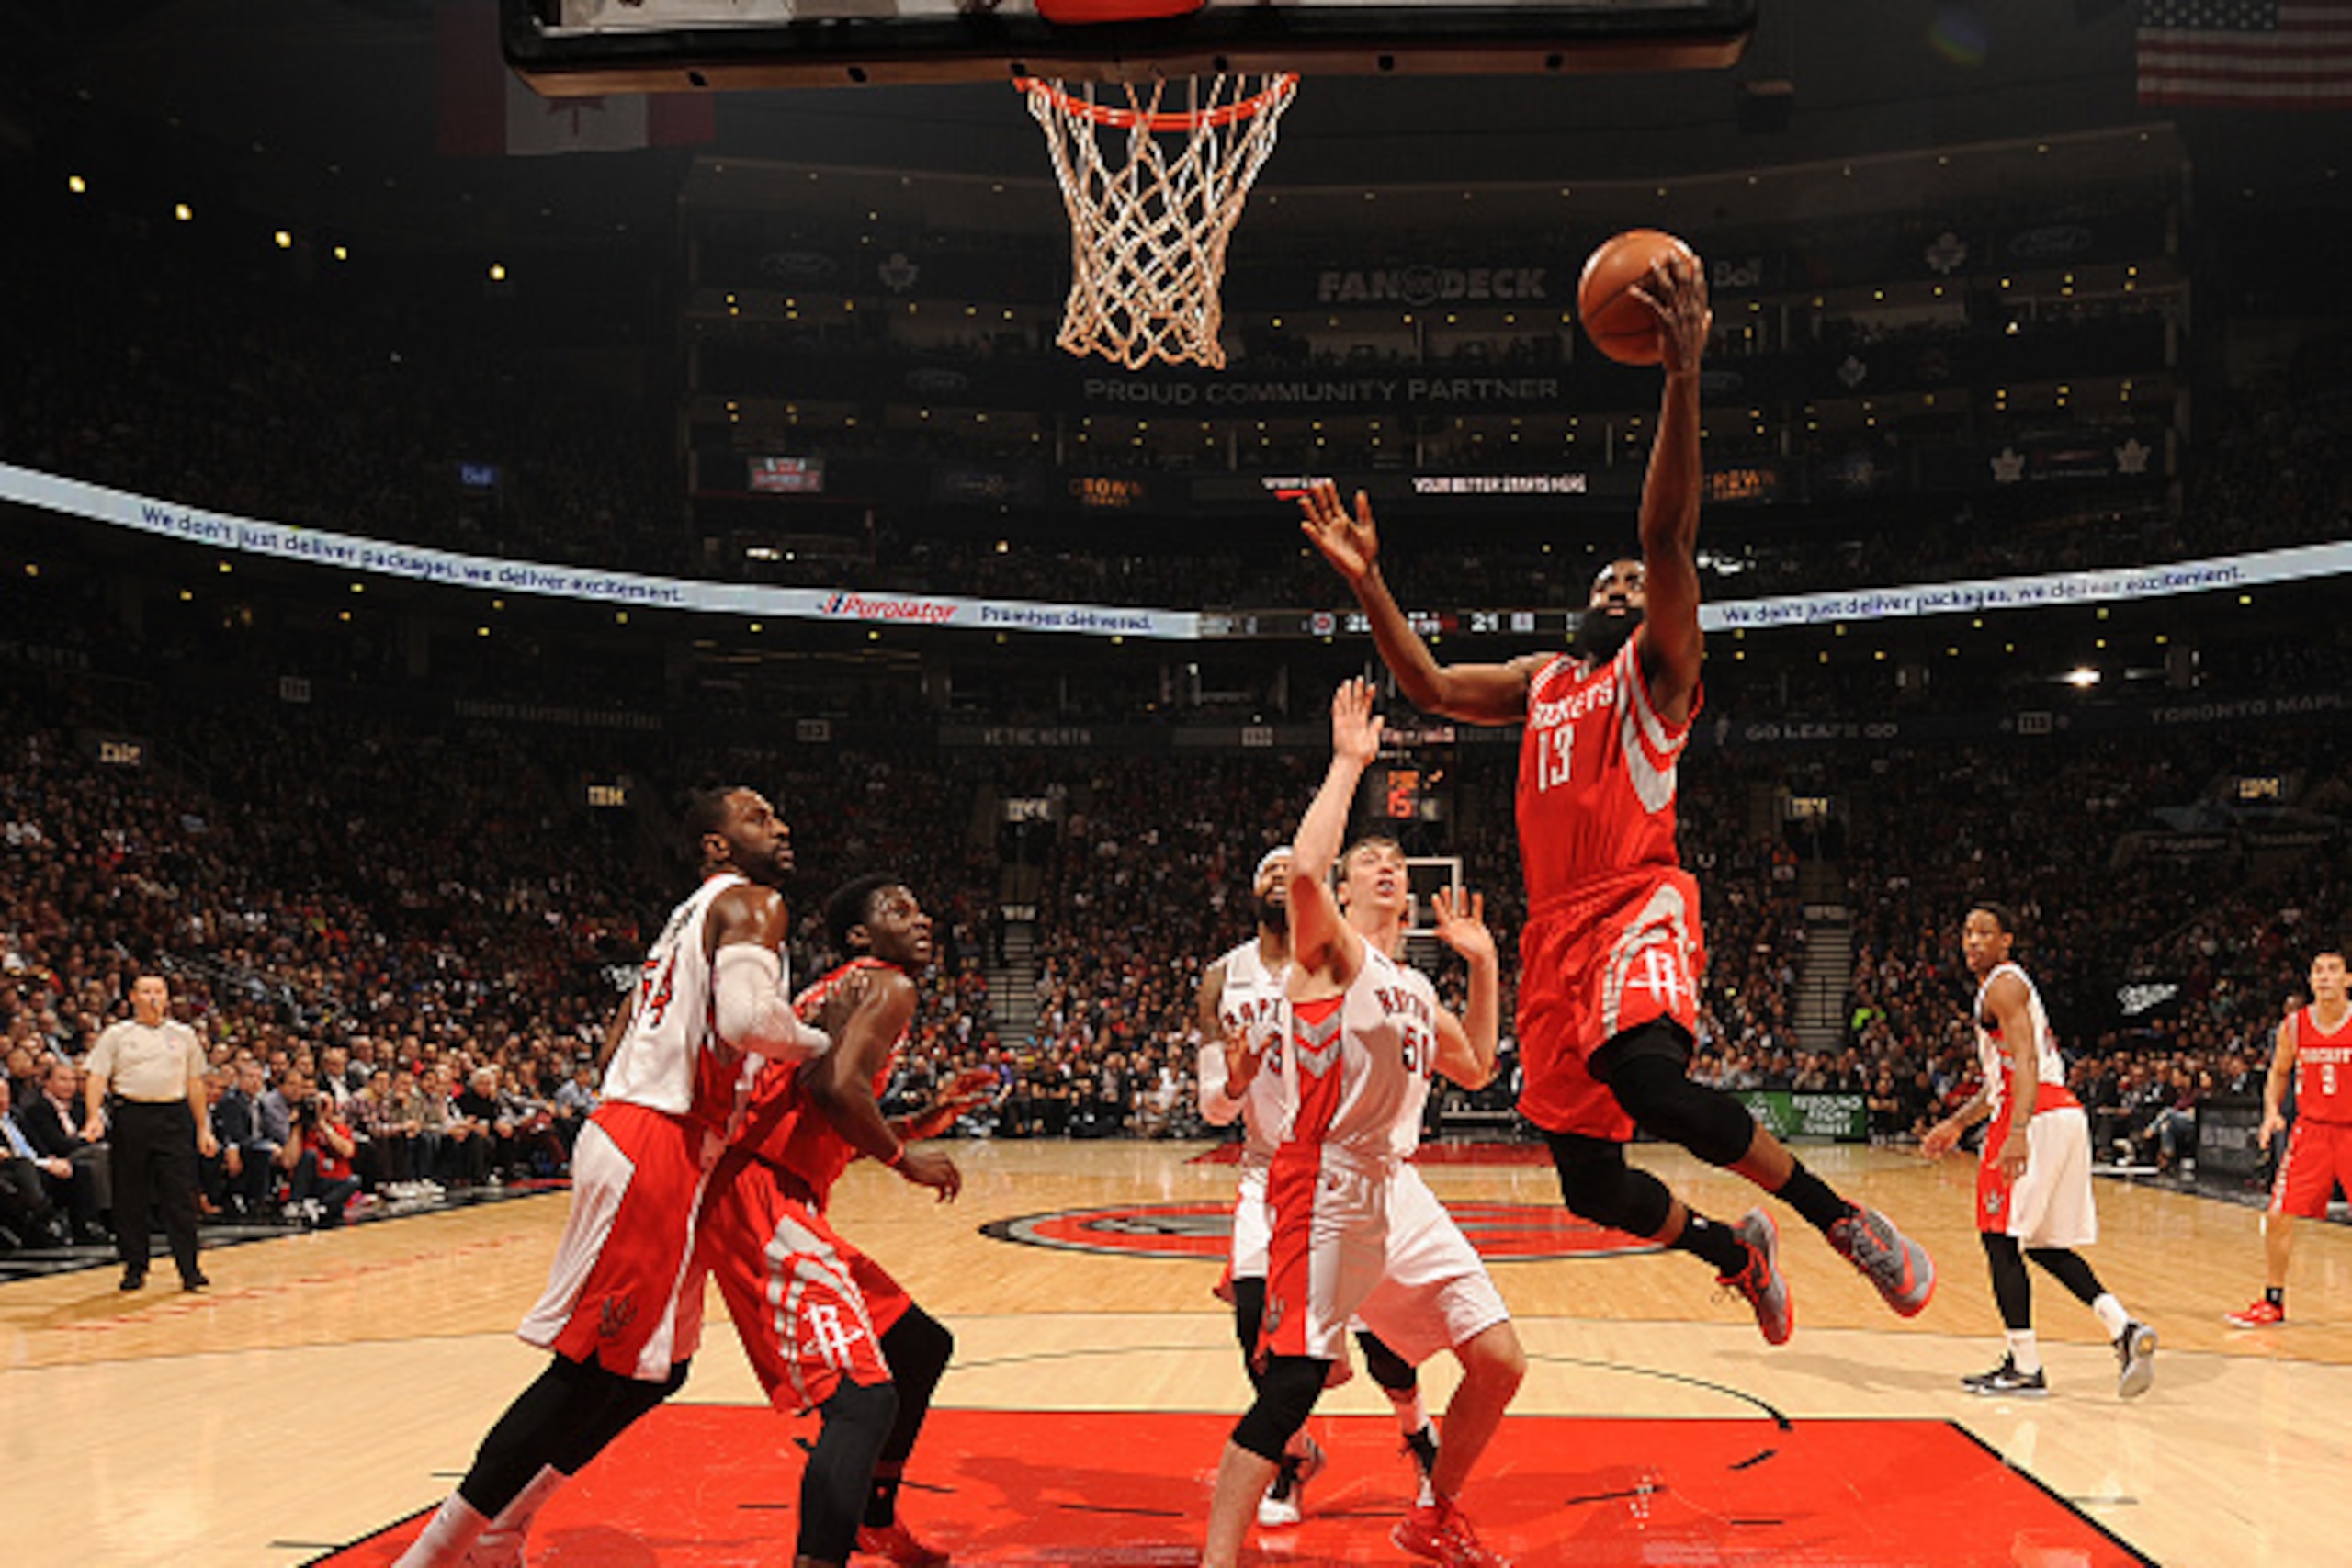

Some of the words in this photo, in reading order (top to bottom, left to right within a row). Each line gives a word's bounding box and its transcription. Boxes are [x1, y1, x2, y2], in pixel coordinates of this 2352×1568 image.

[1317, 270, 1400, 302] FAN
[1440, 268, 1548, 299] DECK
[1084, 378, 1196, 405] PROUD
[1205, 378, 1396, 403] COMMUNITY
[1408, 378, 1559, 401] PARTNER
[141, 505, 173, 527] We
[178, 514, 231, 540] don't
[237, 525, 277, 551] just
[285, 534, 354, 560] deliver
[463, 566, 491, 582] we
[499, 566, 566, 590] deliver
[842, 592, 957, 623] Purolator
[1722, 607, 1749, 624] We
[1753, 603, 1803, 622] don't
[1805, 600, 1842, 624] just
[1844, 595, 1909, 615] deliver
[2018, 586, 2045, 599] we
[2274, 693, 2346, 715] MAPL
[1537, 722, 1575, 794] 13
